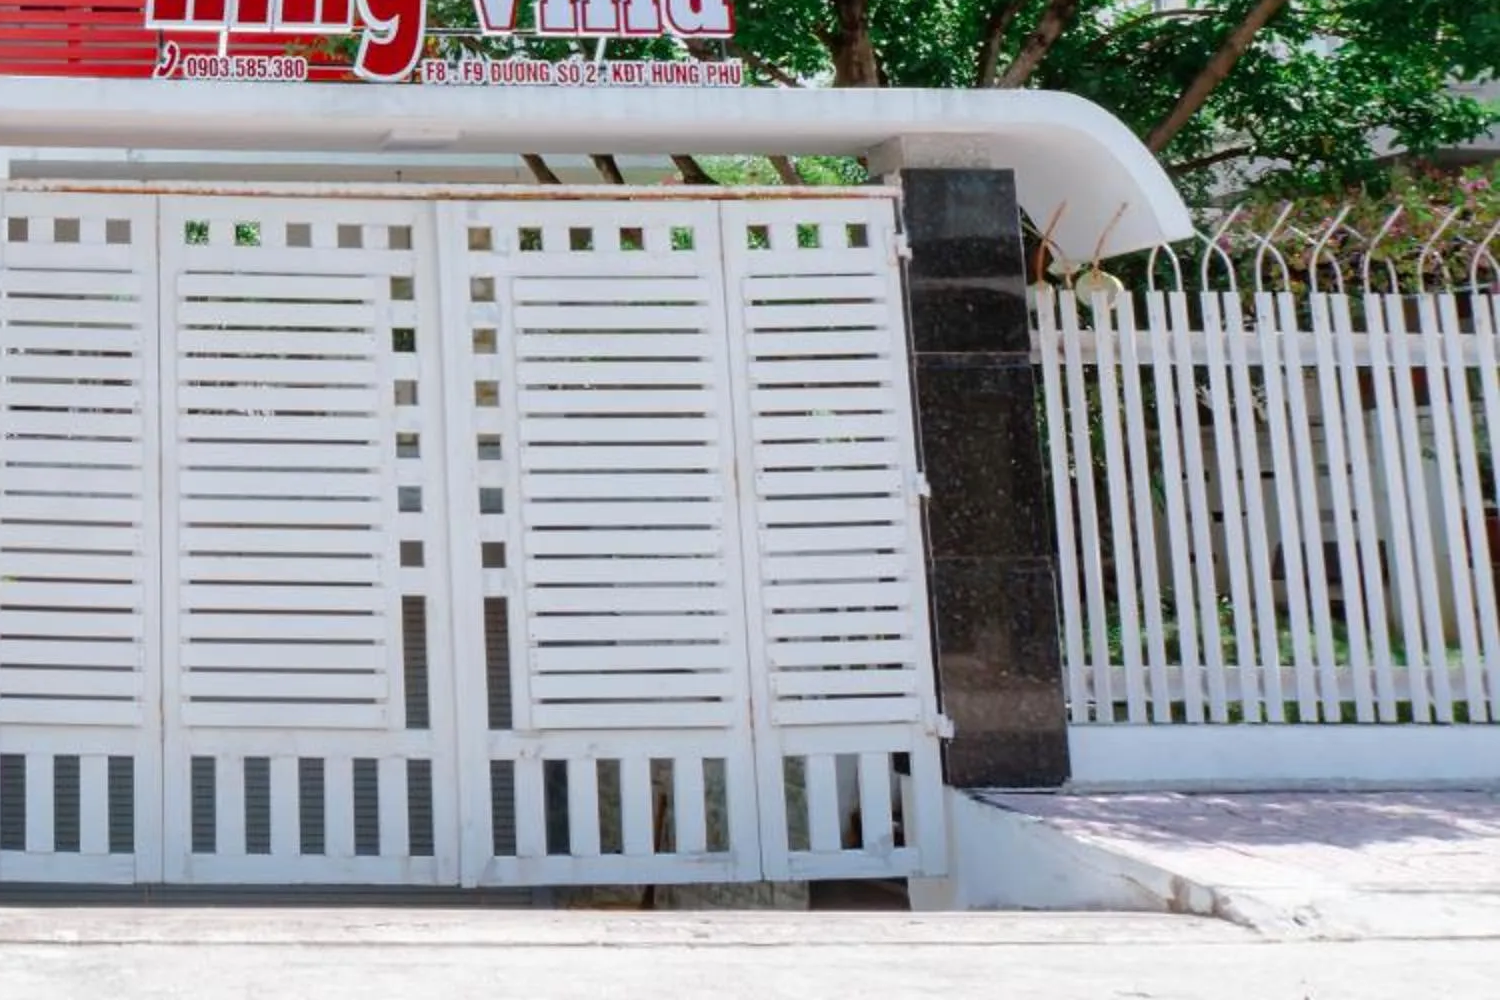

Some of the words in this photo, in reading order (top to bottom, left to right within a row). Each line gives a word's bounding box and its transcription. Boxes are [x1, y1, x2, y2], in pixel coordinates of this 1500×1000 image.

[186, 56, 306, 79] 0903.585.380
[426, 61, 446, 82] F8
[463, 61, 484, 82] F9
[585, 63, 597, 83] 2
